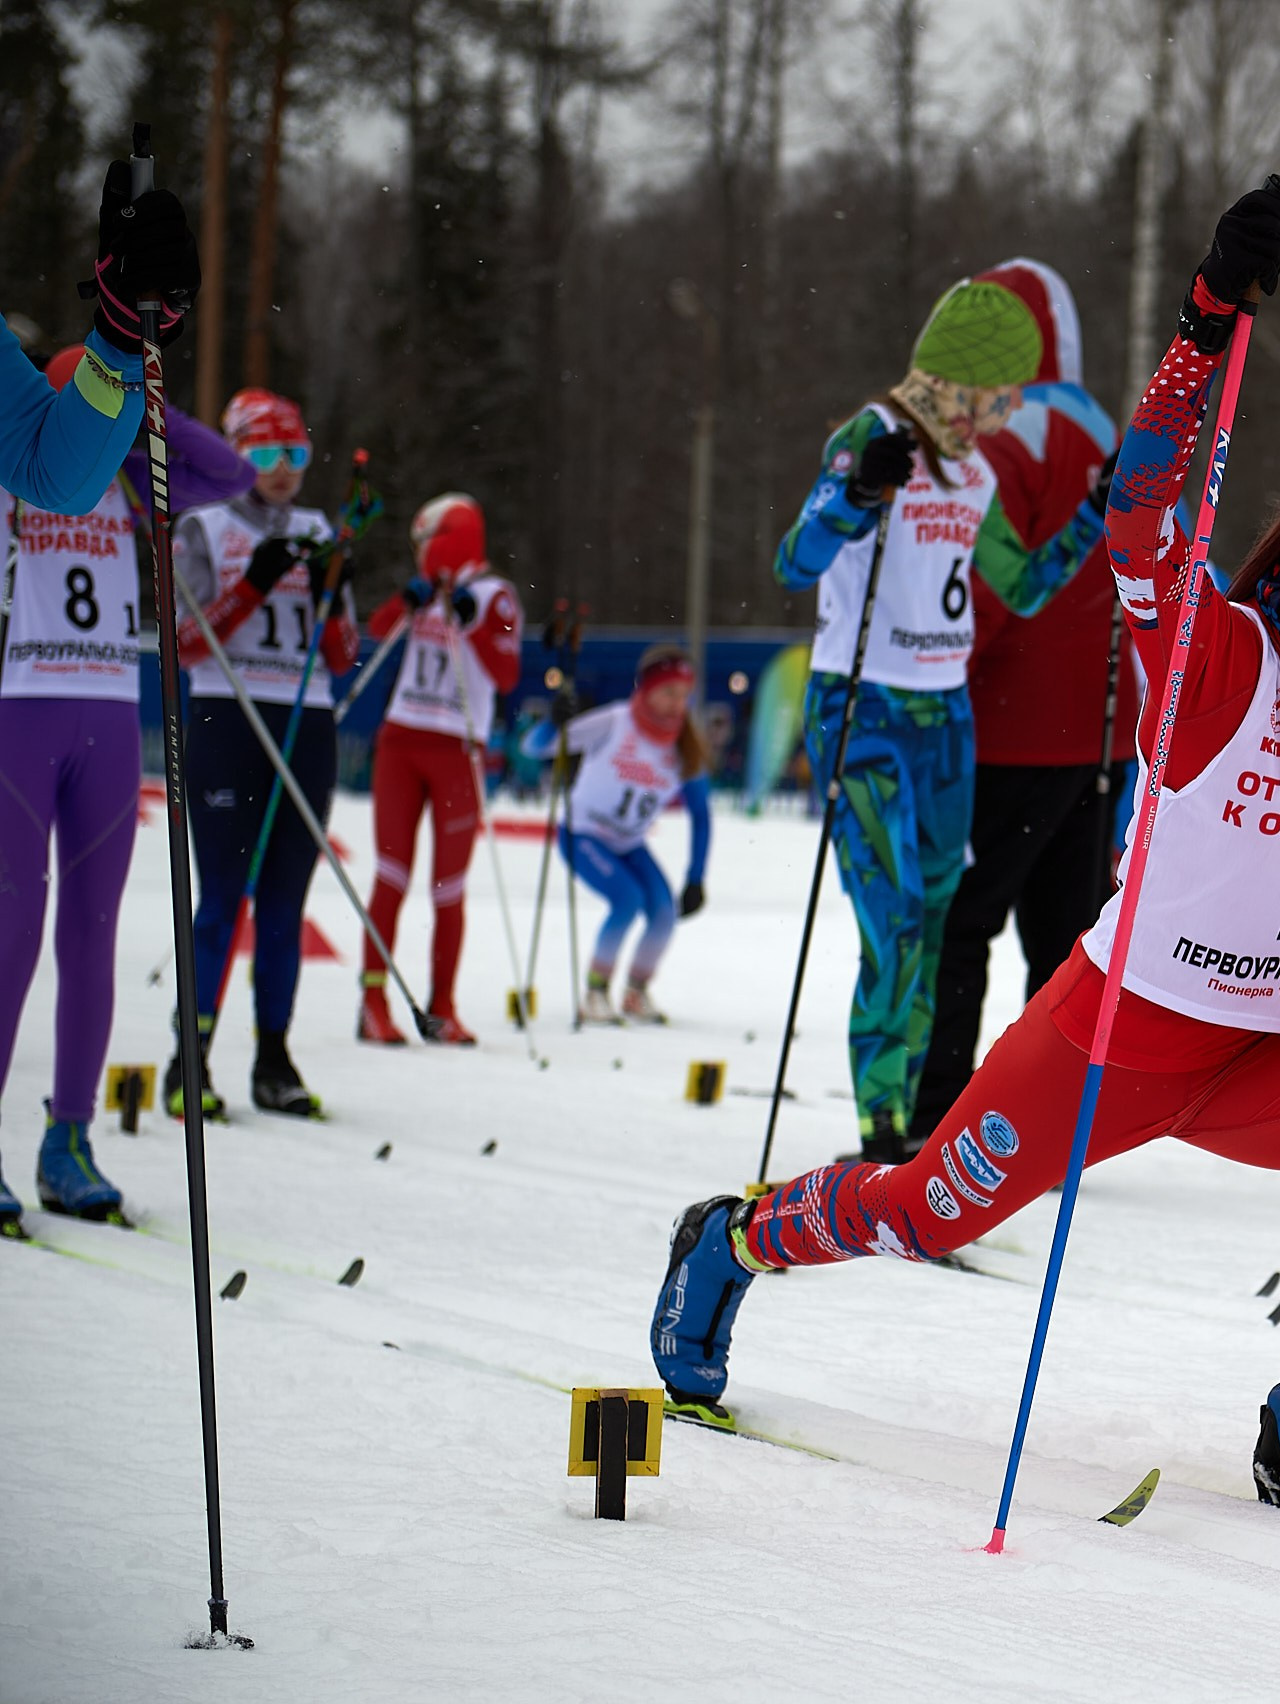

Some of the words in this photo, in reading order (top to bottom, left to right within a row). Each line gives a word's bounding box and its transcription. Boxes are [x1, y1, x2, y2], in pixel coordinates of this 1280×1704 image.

[143, 338, 167, 433] KV+
[1207, 427, 1231, 508] KV+
[903, 501, 981, 526] ПИОНЕРСК
[19, 531, 119, 561] ПРАВДА
[916, 523, 976, 550] ПРАВД
[66, 565, 99, 631] 8
[942, 557, 967, 622] 6
[125, 603, 138, 637] 1
[170, 714, 180, 804] TEMPESTA
[1142, 805, 1156, 850] JUNIOR
[1222, 799, 1247, 828] К
[1207, 978, 1274, 999] Пионерка
[660, 1262, 688, 1356] SPINE
